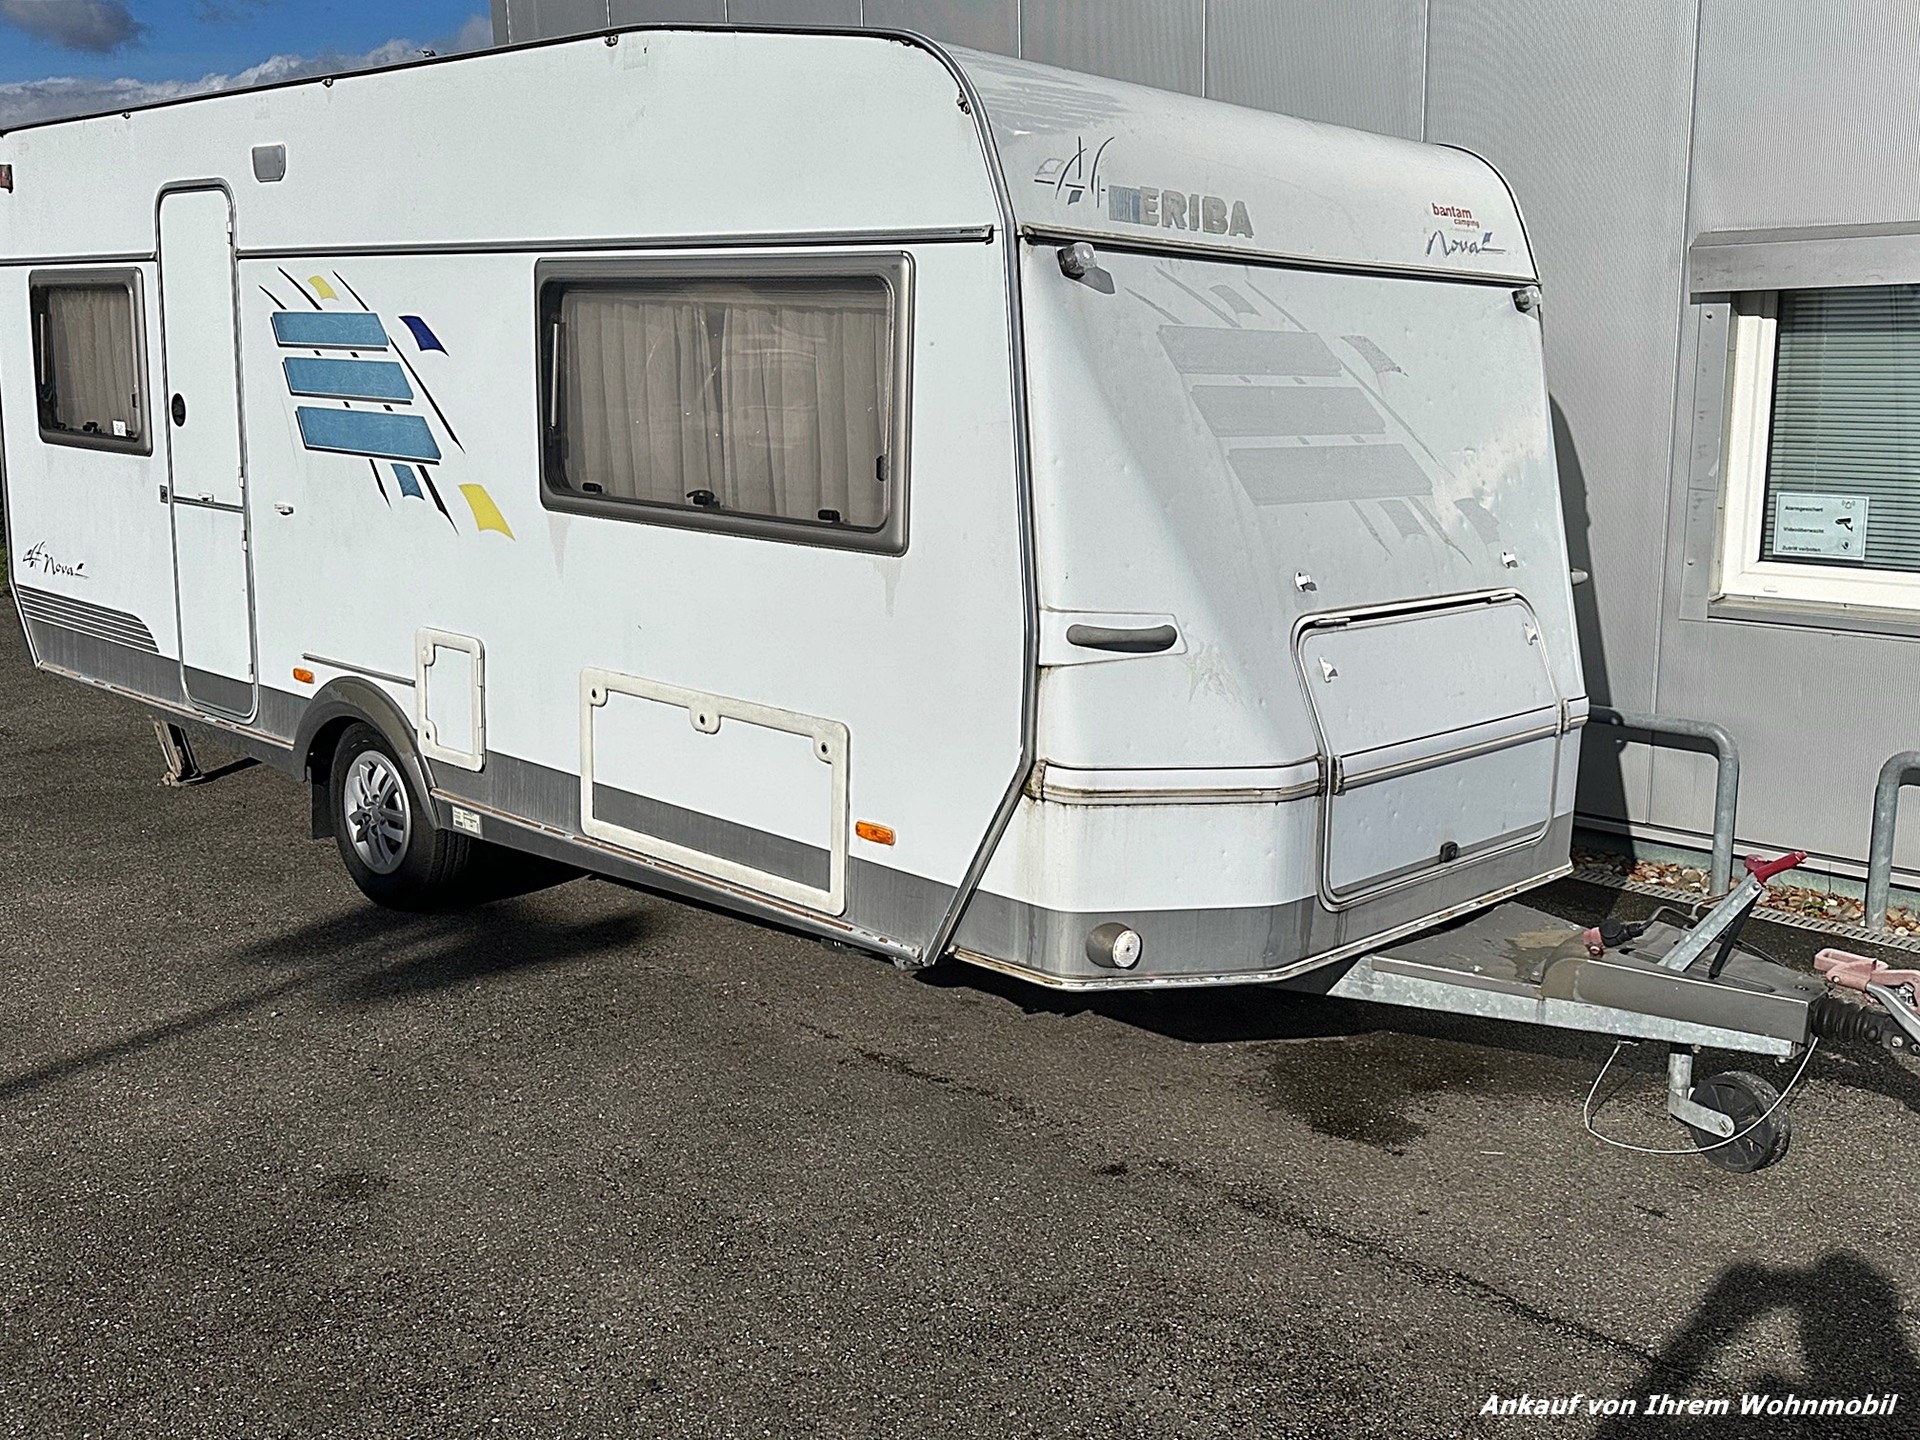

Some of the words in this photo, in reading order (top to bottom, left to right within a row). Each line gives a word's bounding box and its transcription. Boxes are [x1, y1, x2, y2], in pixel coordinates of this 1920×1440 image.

[1139, 186, 1254, 238] ERIBA
[1431, 202, 1472, 219] bantam
[1453, 218, 1480, 229] camping
[1426, 230, 1483, 257] Nova
[44, 553, 74, 576] Nova
